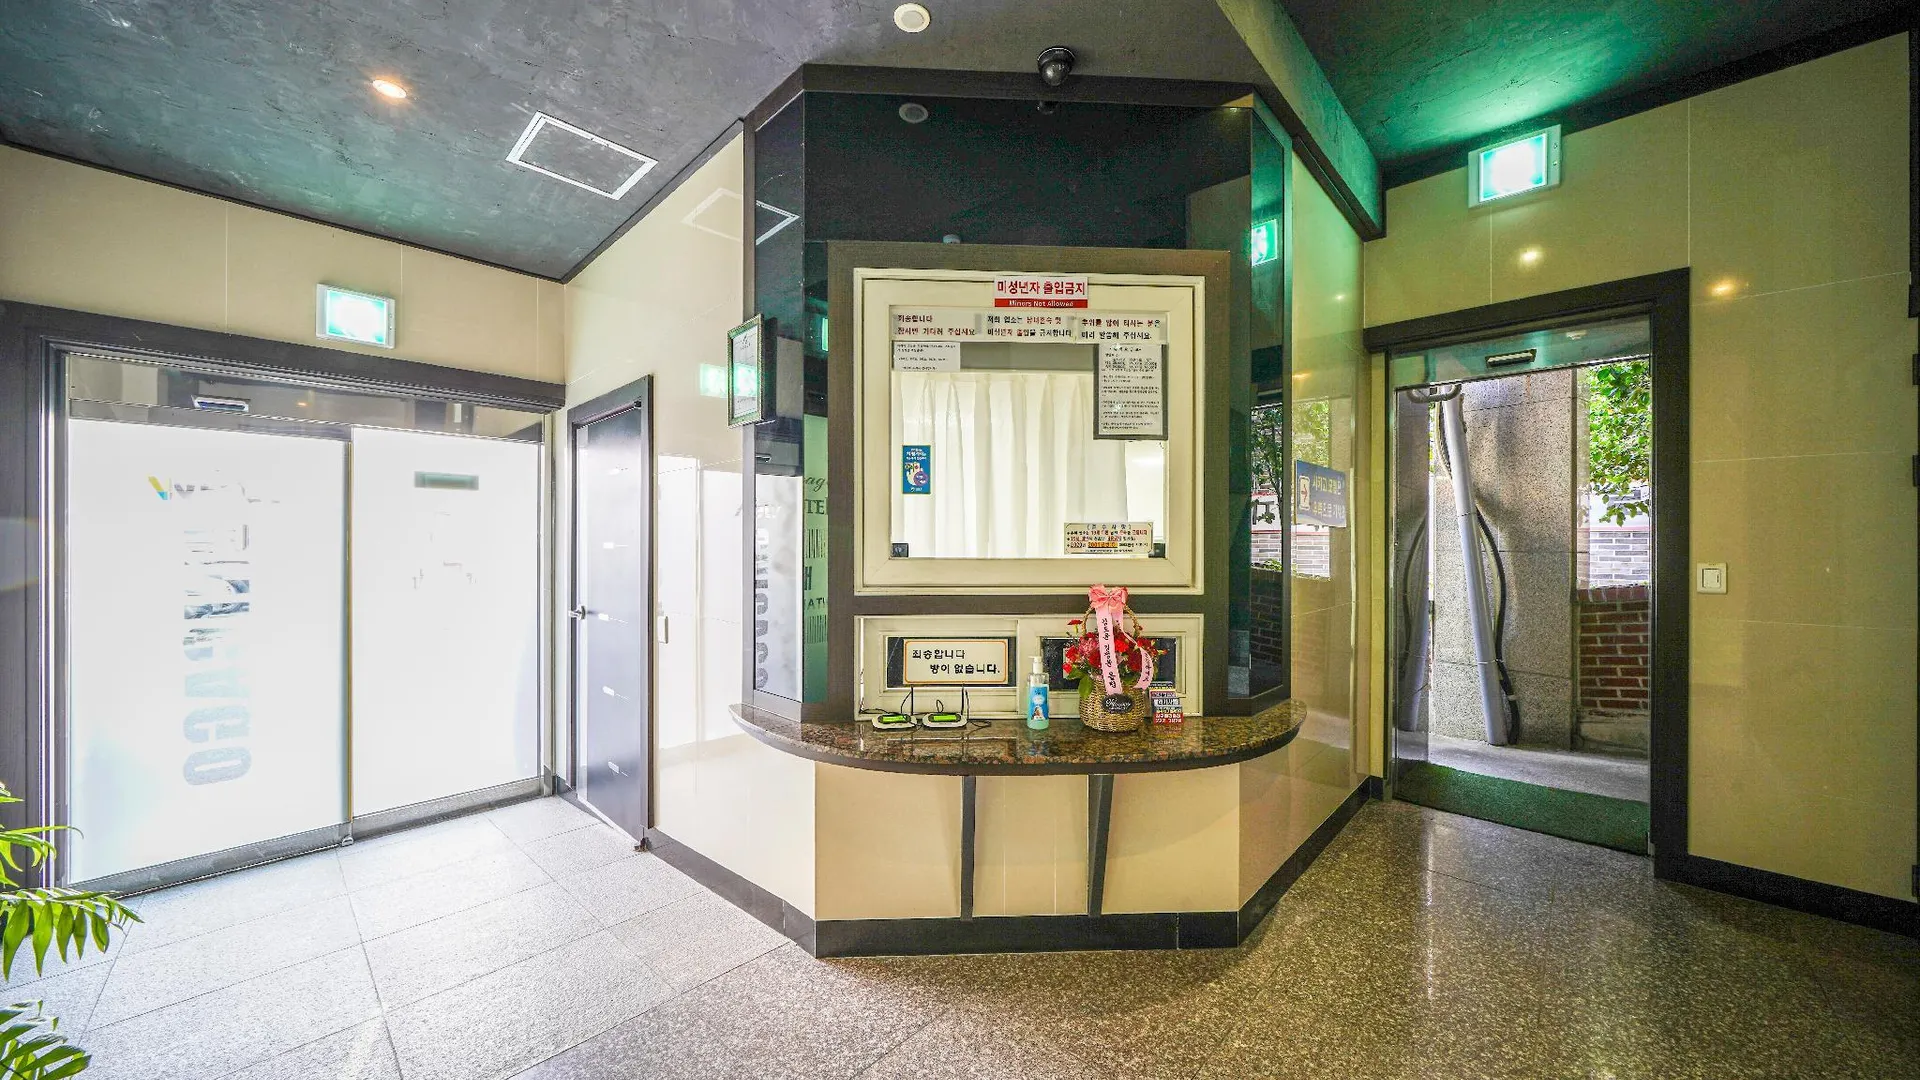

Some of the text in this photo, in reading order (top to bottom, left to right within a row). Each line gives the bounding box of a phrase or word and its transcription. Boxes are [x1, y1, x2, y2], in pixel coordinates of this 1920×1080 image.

[997, 281, 1085, 295] 미성년자 출입금지
[923, 327, 943, 336] 기다려
[987, 328, 1013, 336] 미성년자
[1081, 331, 1095, 340] 미리
[912, 649, 965, 660] 죄송합니다
[930, 664, 1000, 675] 방이 없습니다.
